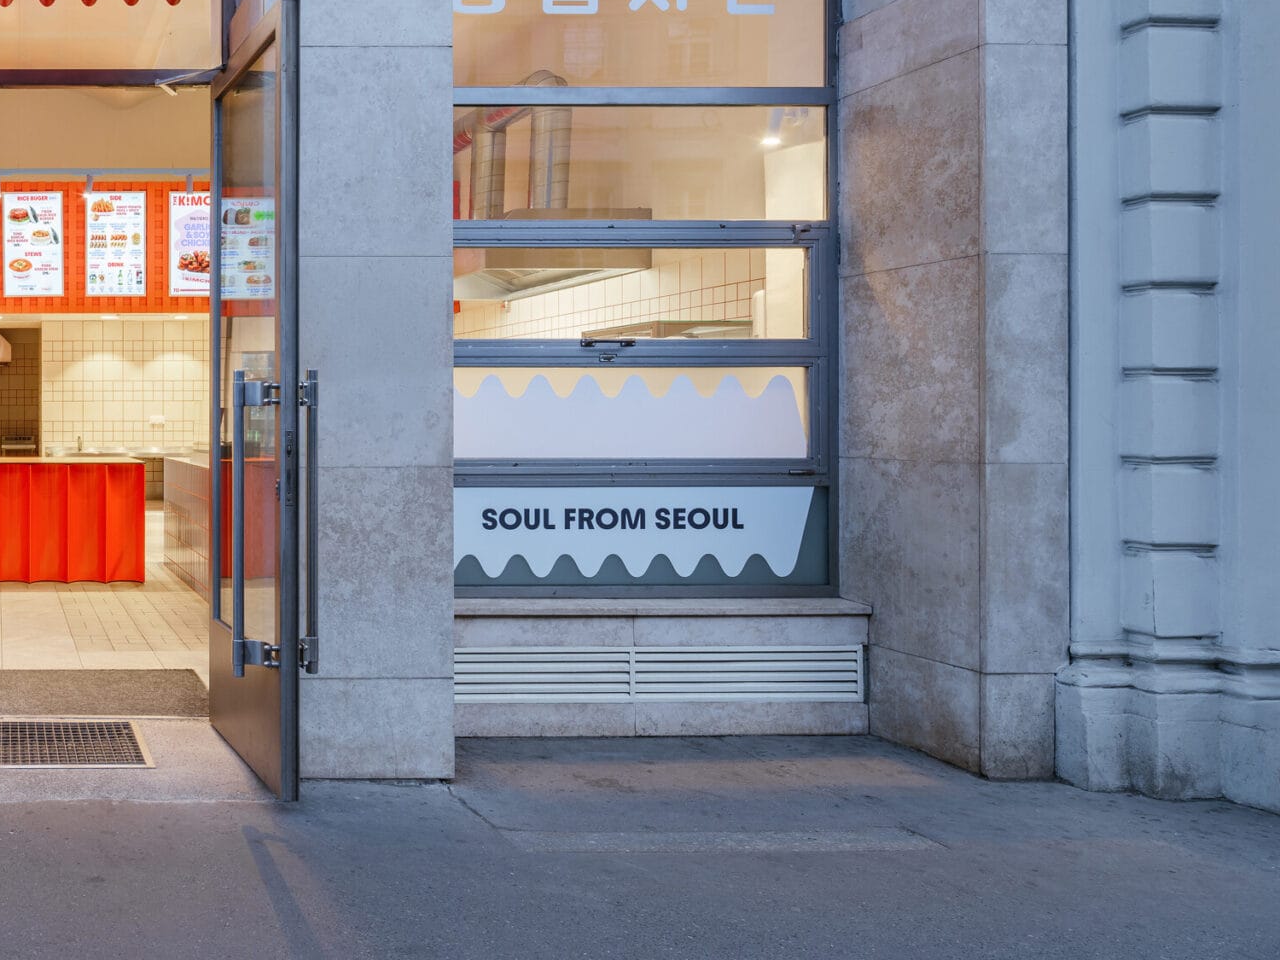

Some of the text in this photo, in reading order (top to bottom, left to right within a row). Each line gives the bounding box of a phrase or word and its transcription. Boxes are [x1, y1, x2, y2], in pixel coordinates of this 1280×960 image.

[178, 195, 210, 206] K!MC
[482, 508, 744, 530] SOUL FROM SEOUL
